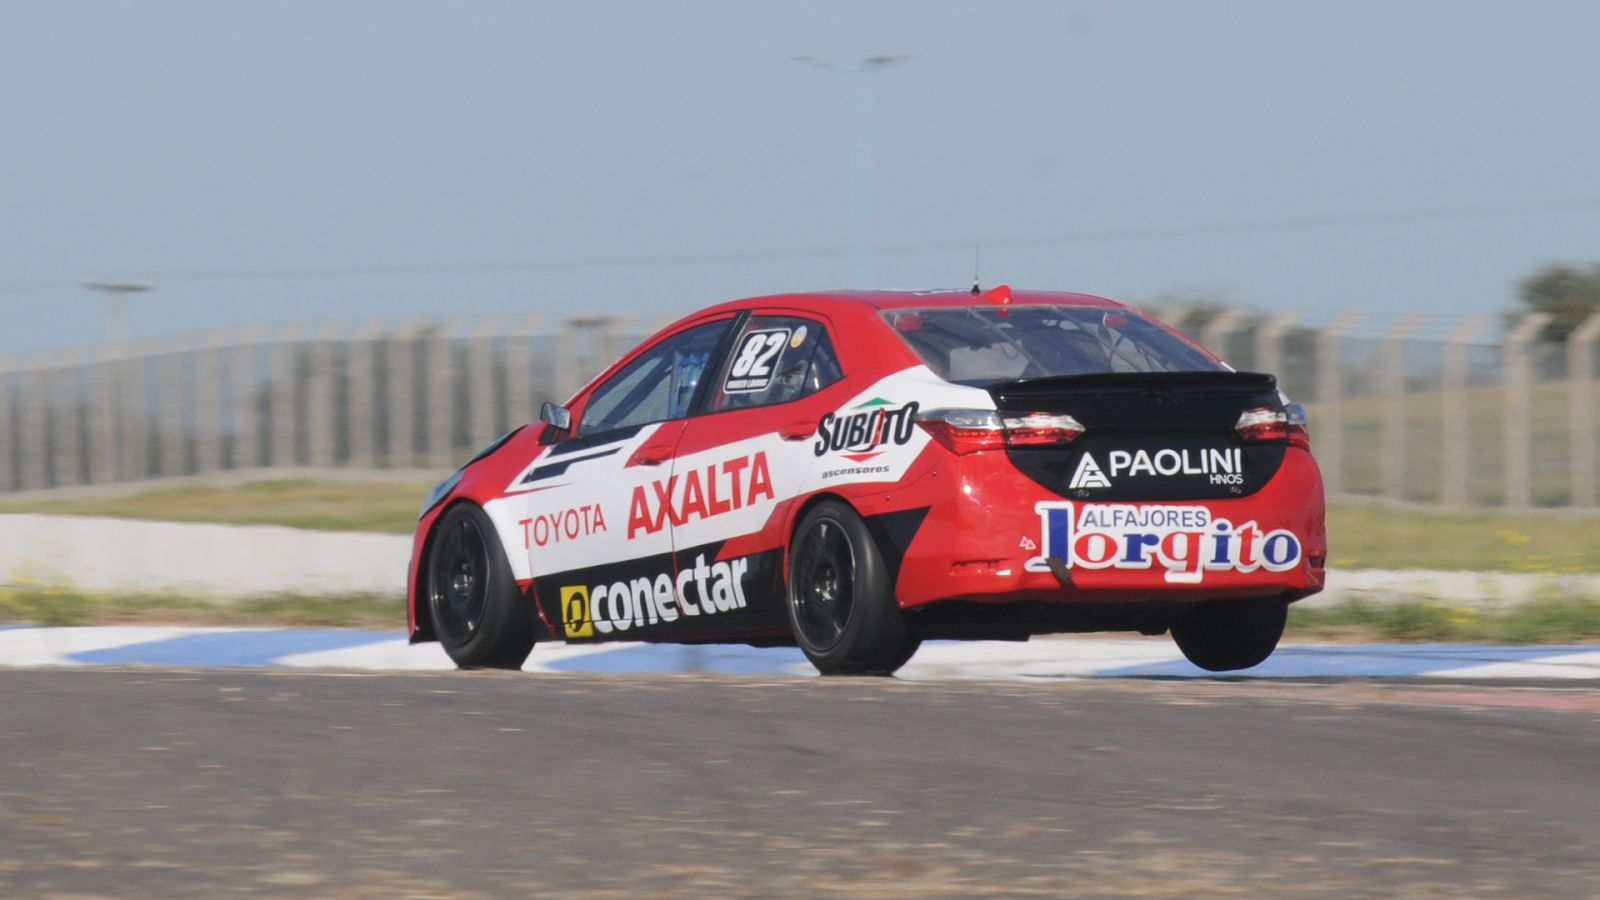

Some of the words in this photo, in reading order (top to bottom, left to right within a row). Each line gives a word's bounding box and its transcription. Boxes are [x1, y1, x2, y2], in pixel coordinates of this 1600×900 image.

[732, 333, 786, 377] 82
[814, 401, 919, 457] SUBITO
[822, 465, 890, 479] ascensores
[1110, 448, 1242, 477] PAOLINI
[1210, 474, 1244, 485] HNOS
[627, 451, 774, 540] AXALTA
[519, 503, 607, 550] TOYOTA
[1083, 509, 1207, 528] ALFAJORES
[590, 553, 748, 634] conectar
